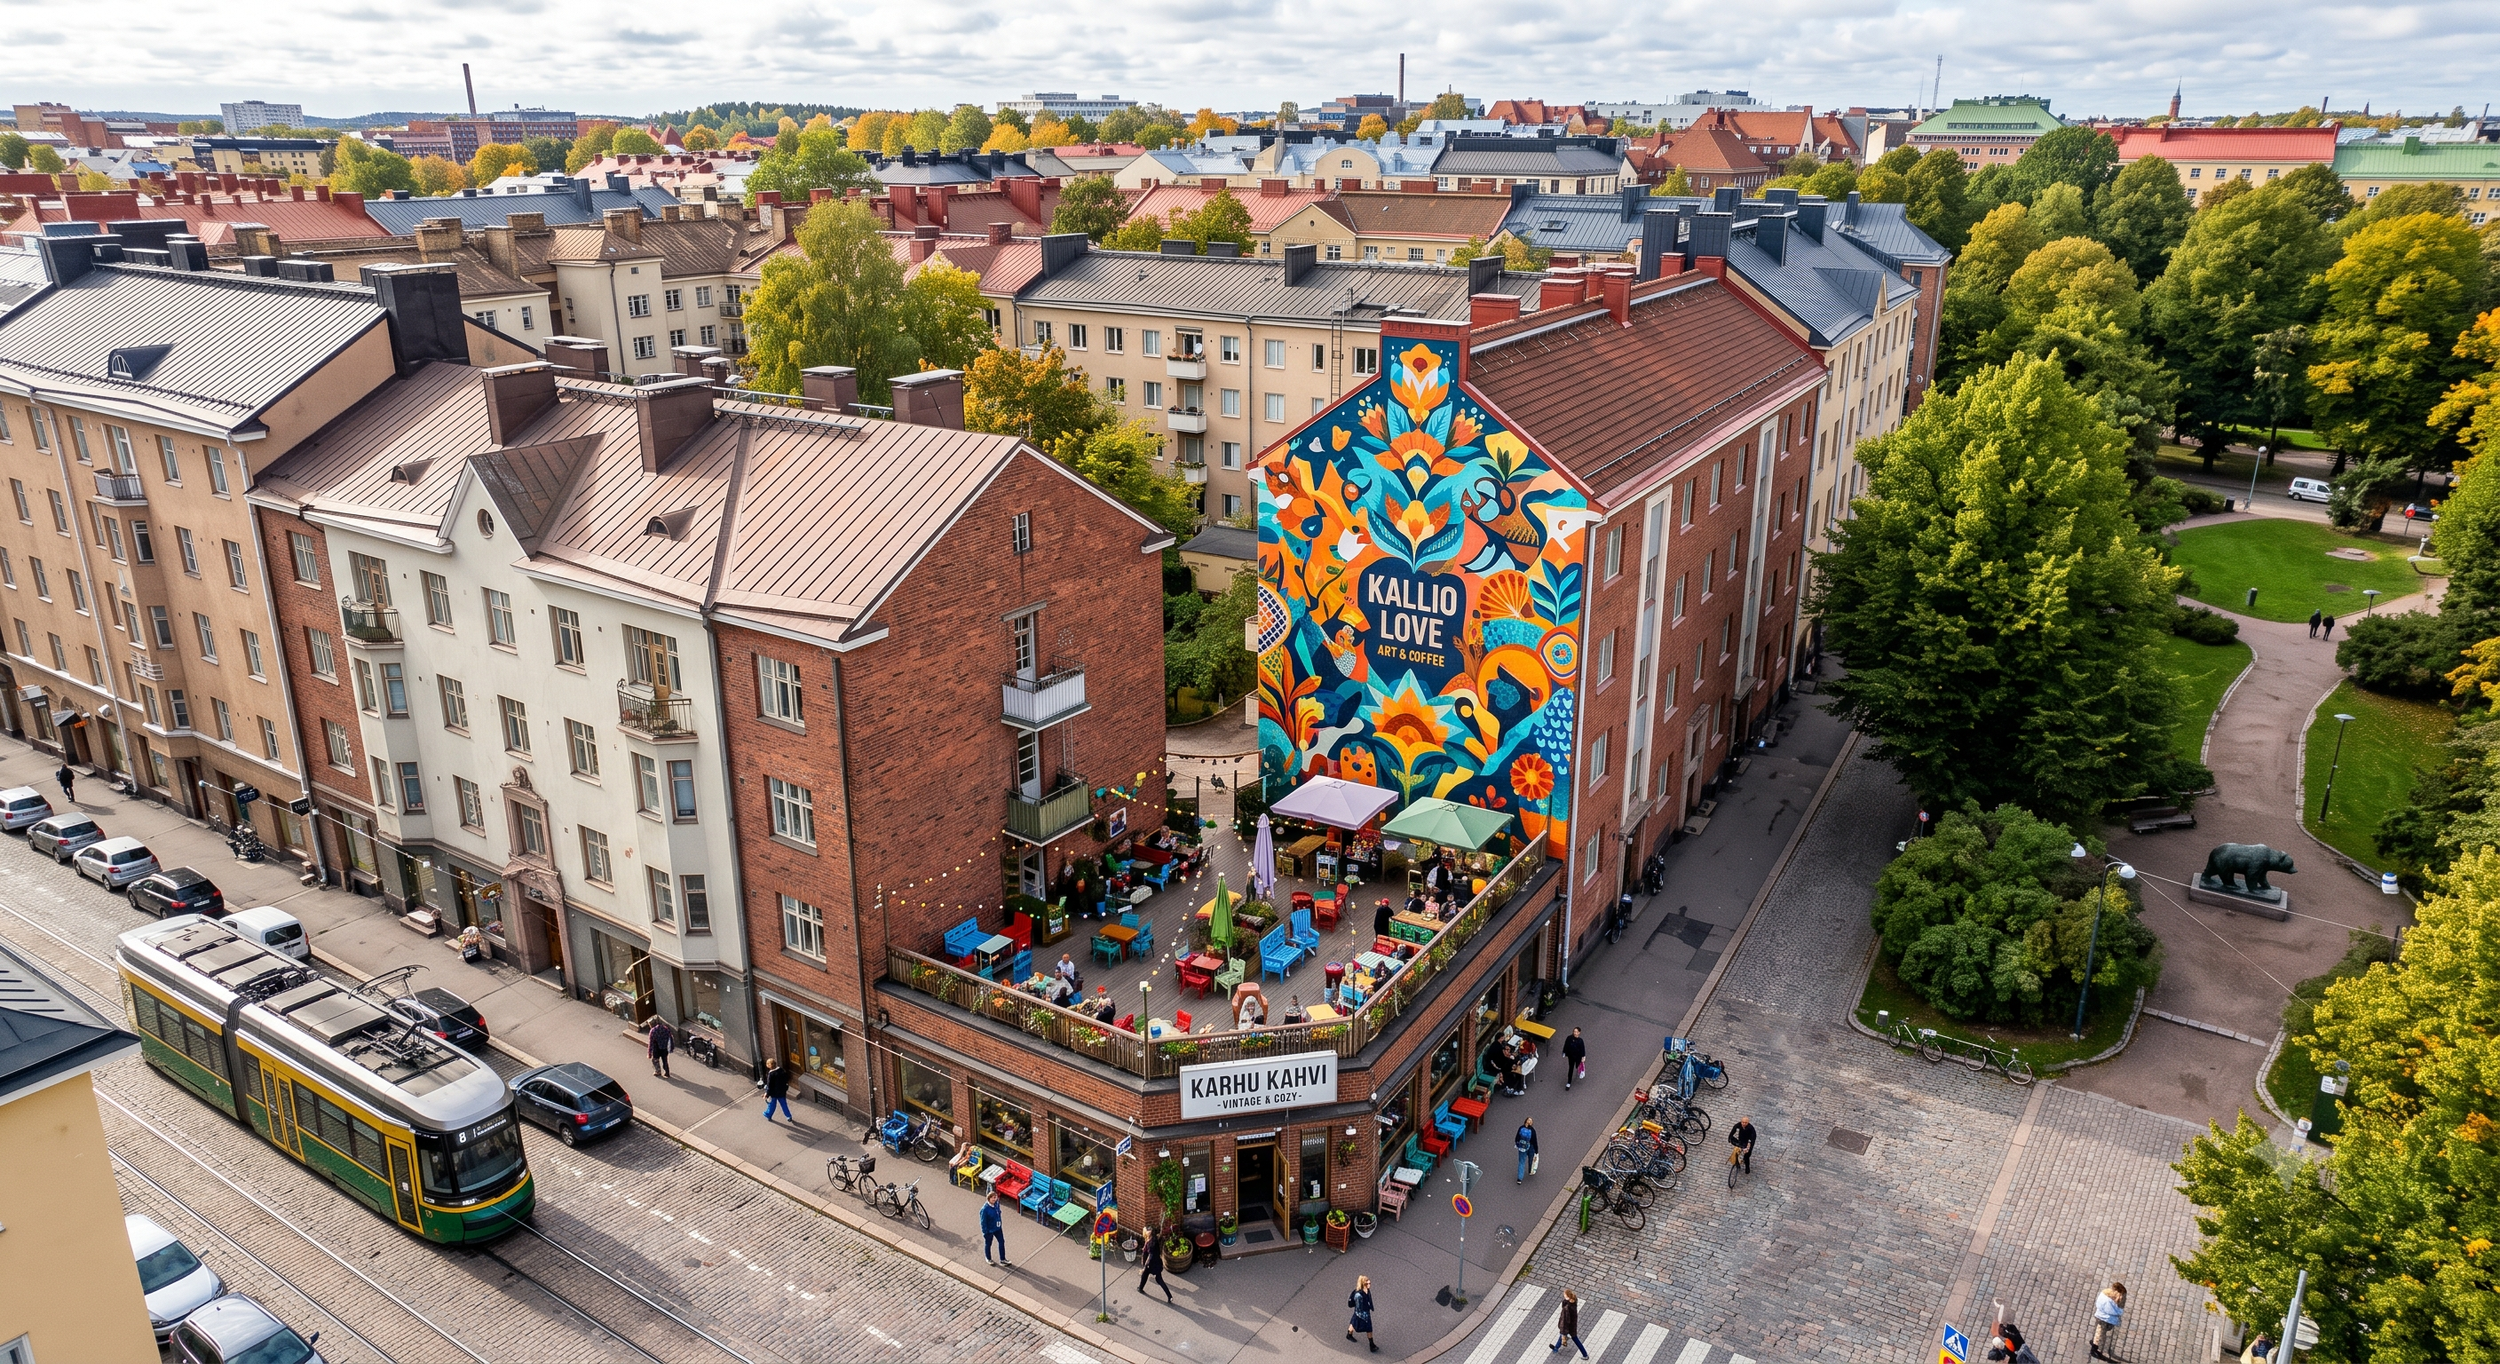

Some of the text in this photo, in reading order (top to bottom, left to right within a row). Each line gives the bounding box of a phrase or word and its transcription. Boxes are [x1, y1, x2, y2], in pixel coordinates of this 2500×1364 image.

[1368, 573, 1457, 616] KALLIO
[1380, 609, 1444, 649] LOVE
[1377, 644, 1445, 668] ART & COFFEE
[1191, 1064, 1327, 1099] KARHU KAHVI
[458, 1131, 467, 1143] 8
